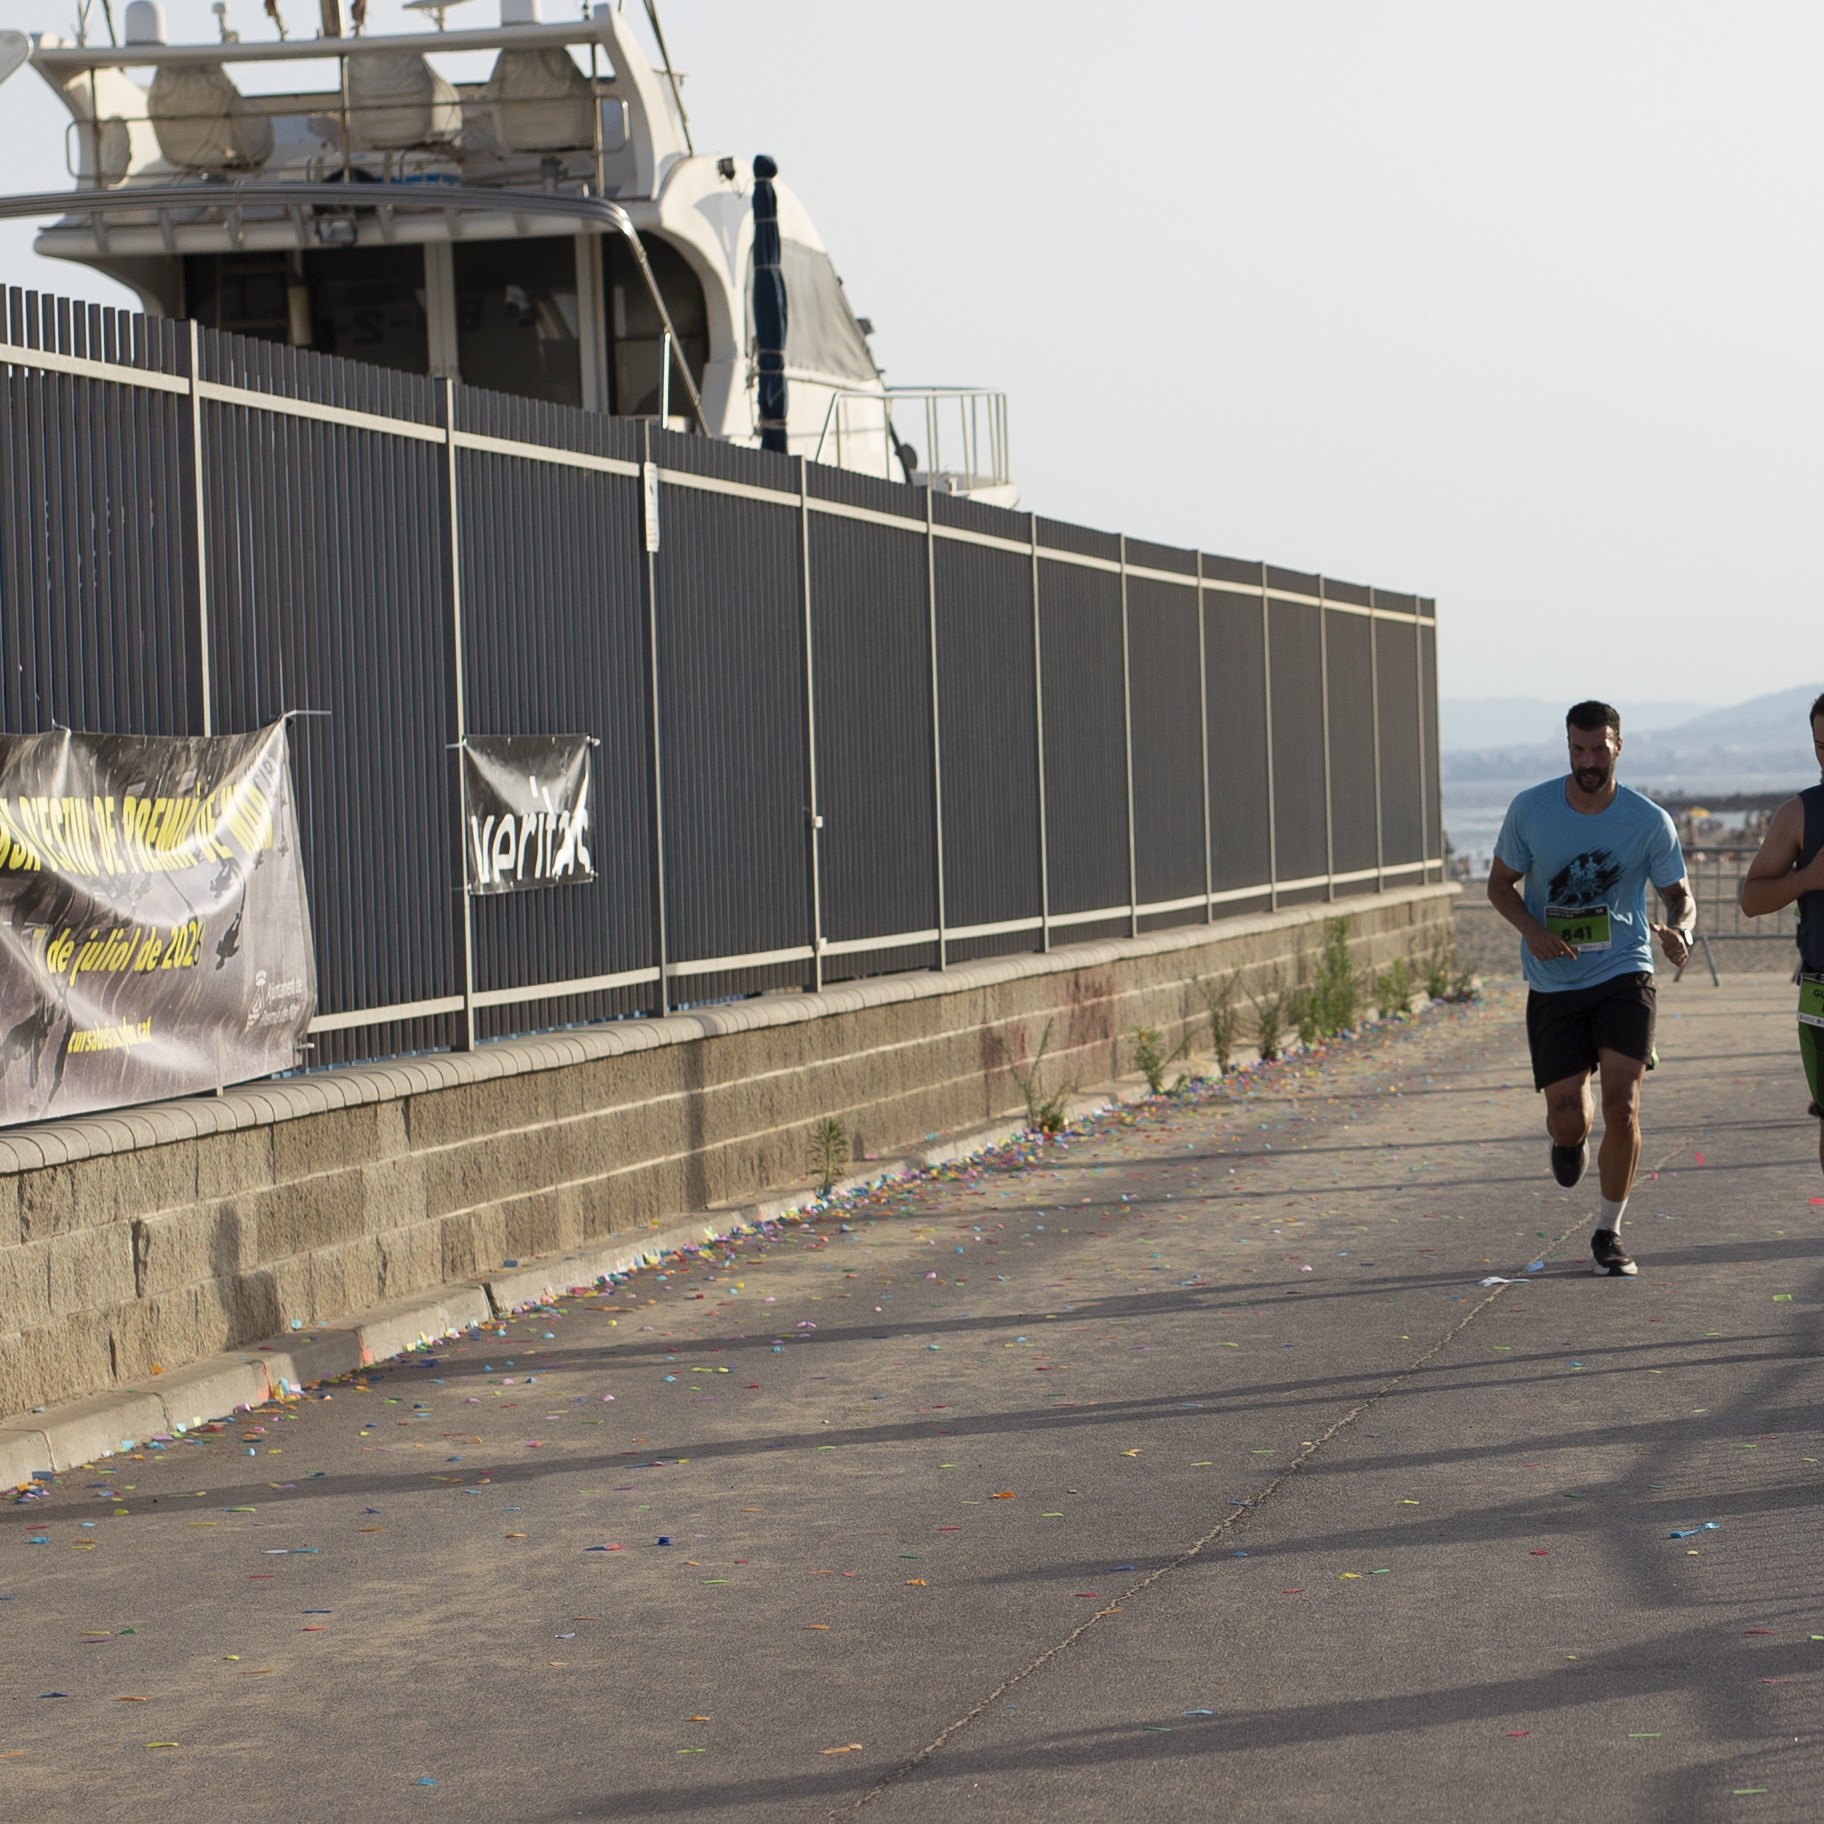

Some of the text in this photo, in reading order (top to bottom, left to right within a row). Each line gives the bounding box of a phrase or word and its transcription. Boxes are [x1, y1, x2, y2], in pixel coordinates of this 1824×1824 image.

[1561, 925, 1592, 942] 841
[46, 927, 75, 974] de
[69, 927, 142, 987] juliol
[134, 926, 163, 972] de
